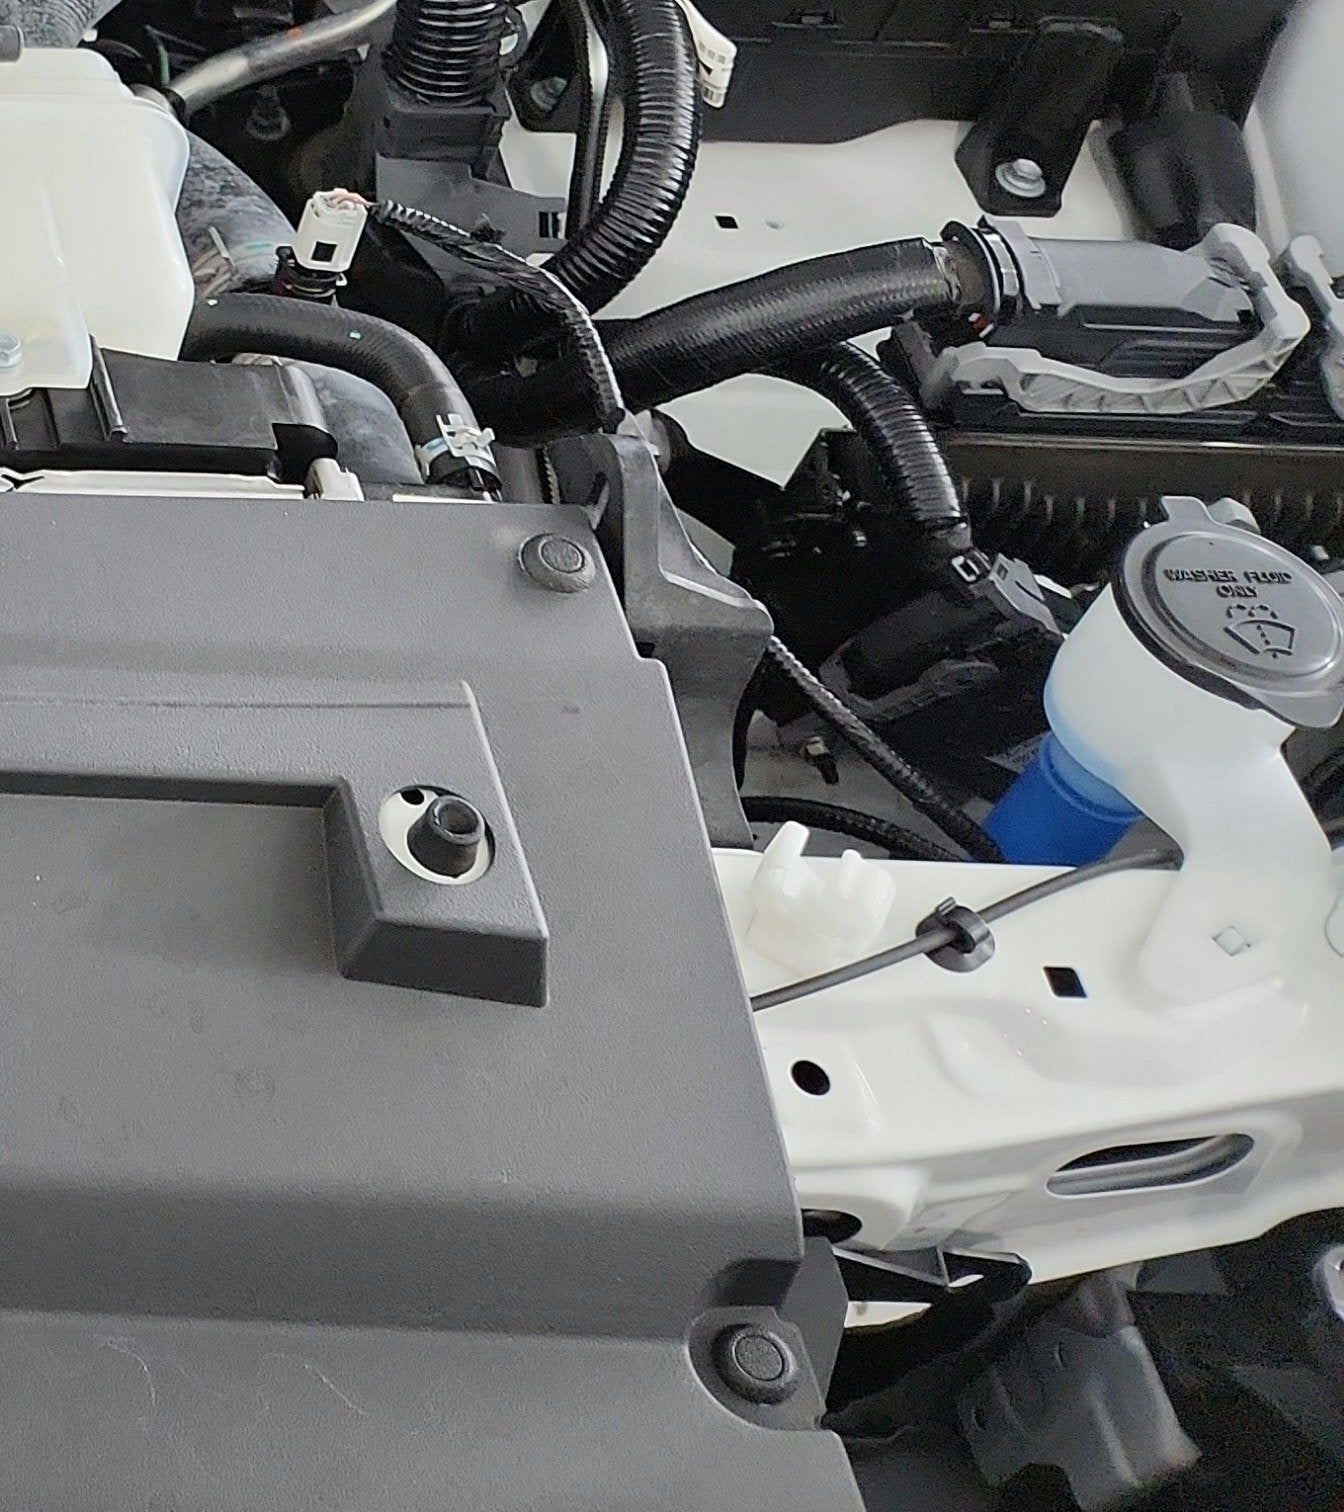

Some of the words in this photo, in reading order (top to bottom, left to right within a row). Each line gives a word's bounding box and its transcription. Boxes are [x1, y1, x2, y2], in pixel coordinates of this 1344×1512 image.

[1162, 568, 1238, 583] WASHER
[1243, 570, 1293, 585] FLUID
[1216, 584, 1258, 598] ONLY
